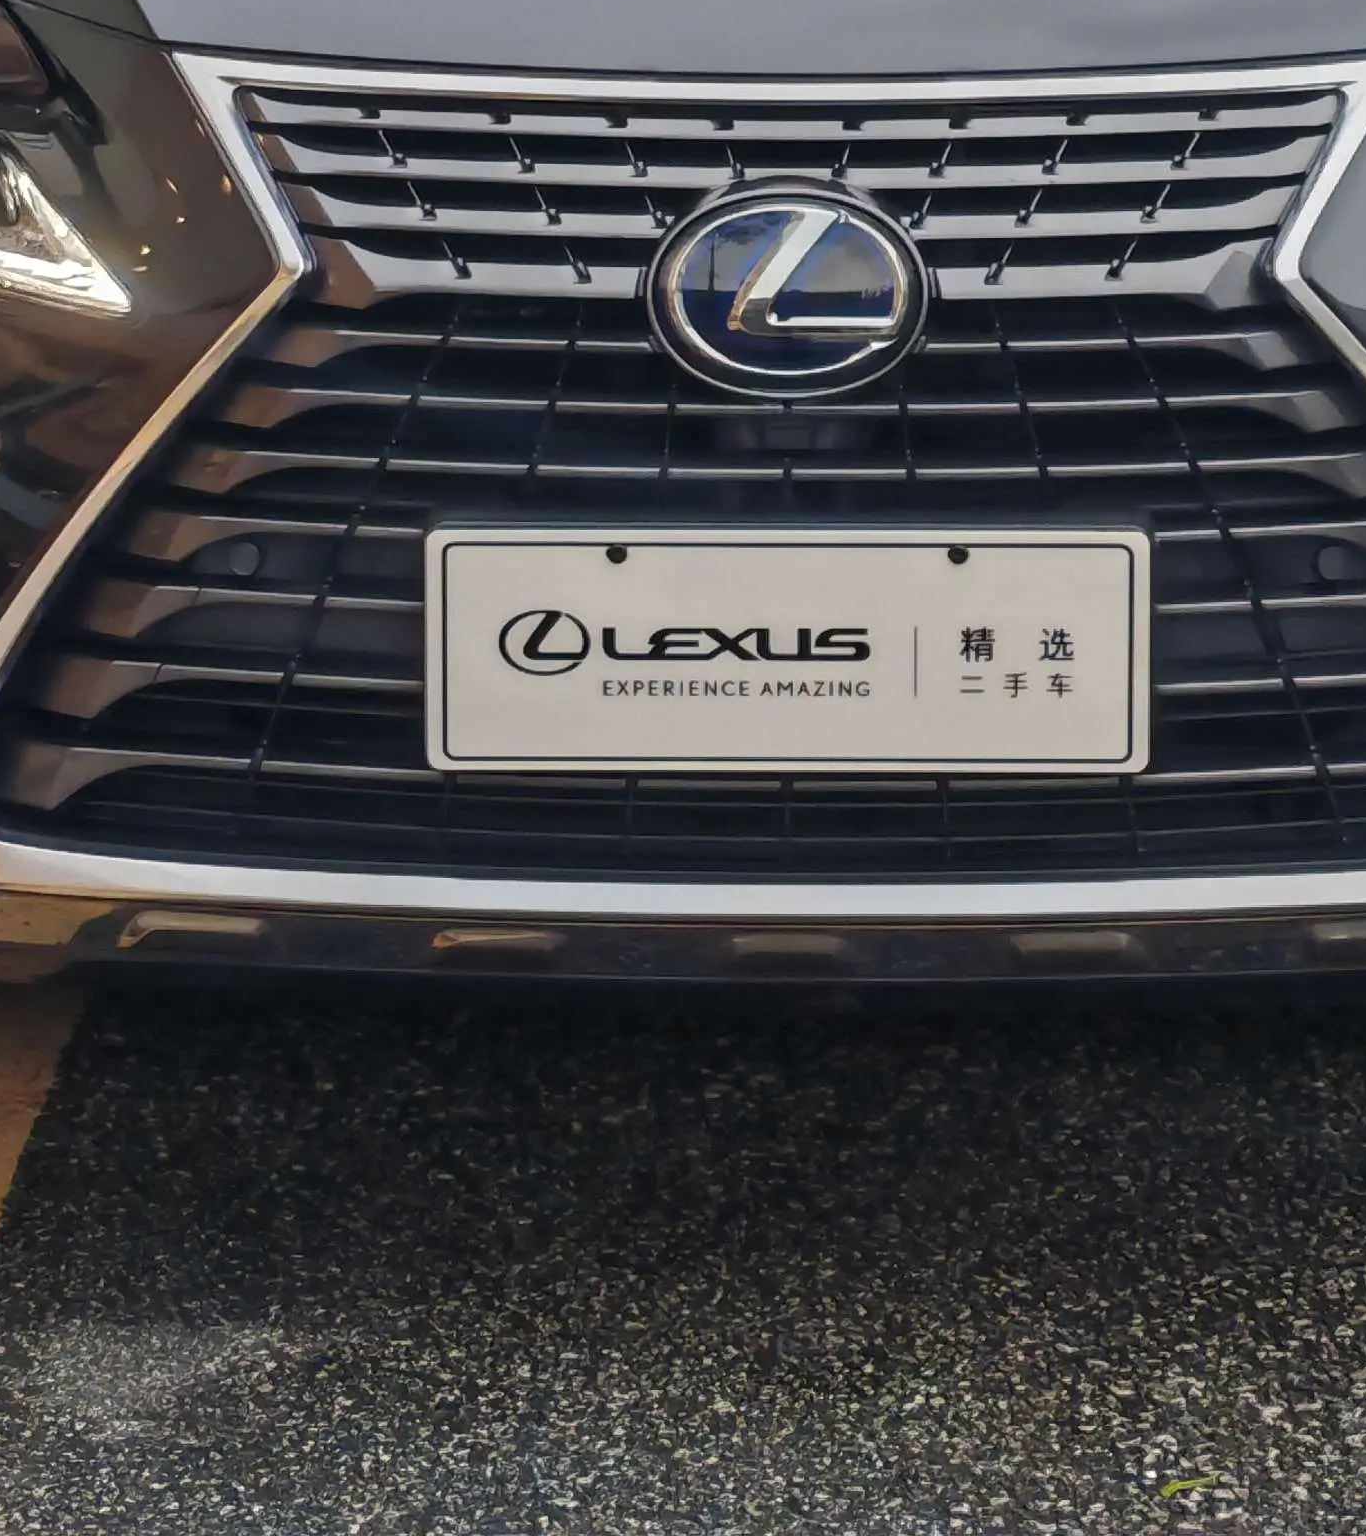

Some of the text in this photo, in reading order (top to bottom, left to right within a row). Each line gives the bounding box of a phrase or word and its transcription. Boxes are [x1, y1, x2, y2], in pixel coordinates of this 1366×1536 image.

[601, 626, 872, 662] LEXUS
[959, 626, 1075, 663] 精选
[602, 679, 871, 698] EXPERIENCE AMAZING
[960, 672, 1073, 699] 二手车
